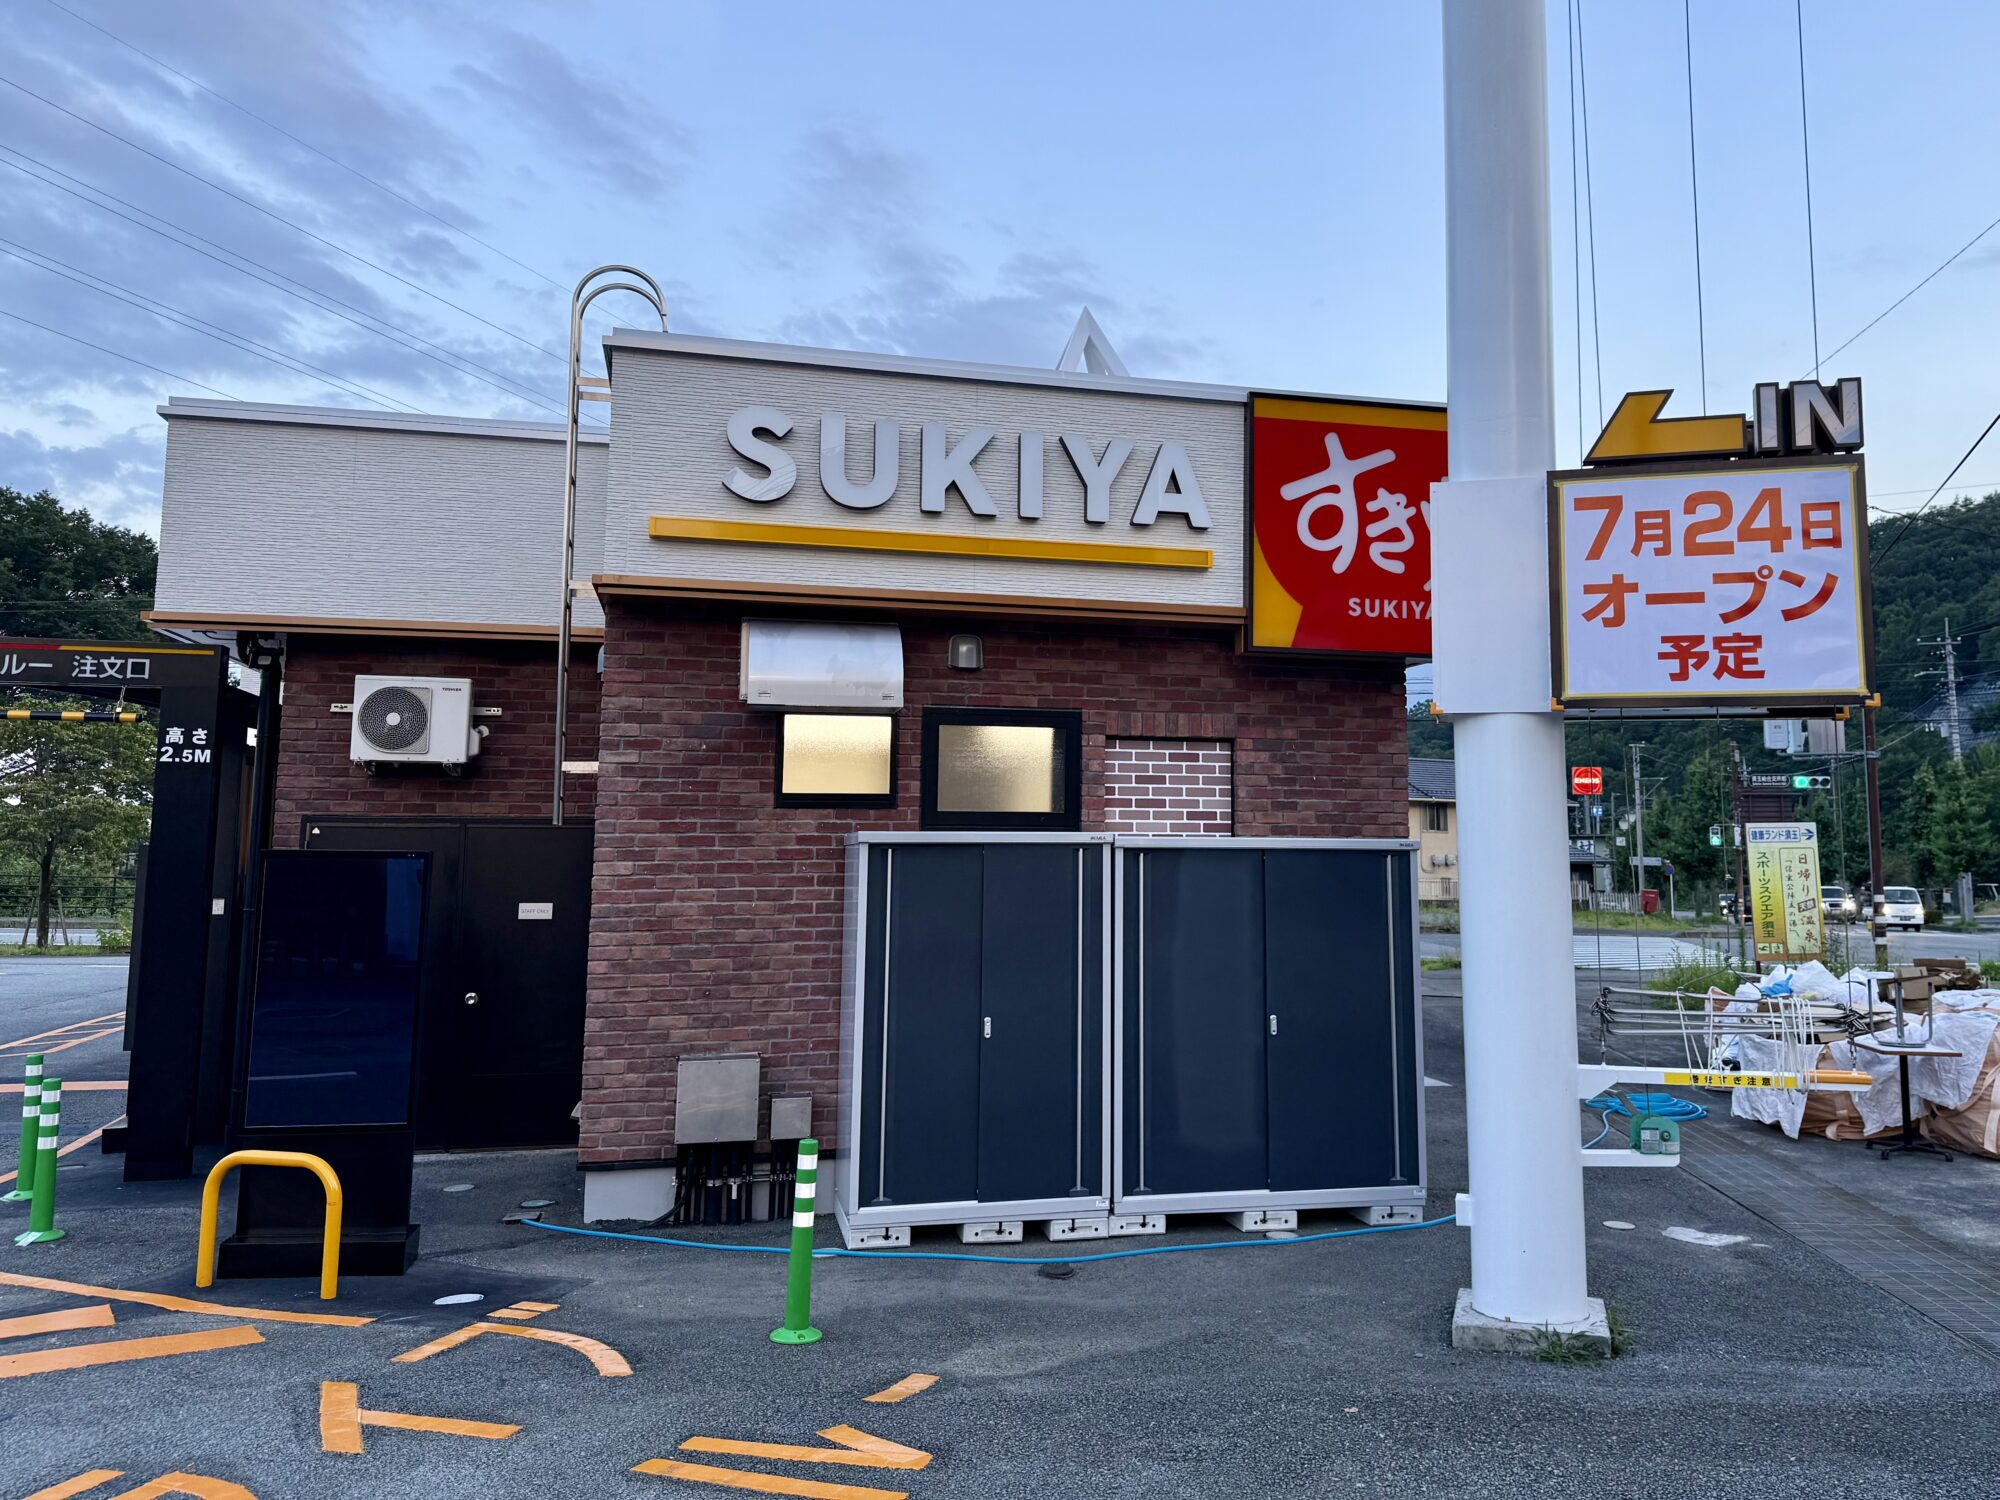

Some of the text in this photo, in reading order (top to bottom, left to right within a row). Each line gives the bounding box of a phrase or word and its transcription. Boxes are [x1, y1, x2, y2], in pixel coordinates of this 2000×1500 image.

[1753, 377, 1865, 455] IN
[721, 405, 1213, 530] SUKIYA
[1280, 432, 1434, 592] すき
[1573, 487, 1842, 561] 7月24日
[1581, 565, 1839, 628] オープン
[0, 653, 150, 679] ルー 注文口
[1657, 632, 1766, 682] 予定
[160, 747, 211, 763] 2.5M
[165, 727, 208, 745] 高さ
[1751, 829, 1798, 841] 健康ランド須玉
[1756, 852, 1776, 938] スポーツスクエア須玉
